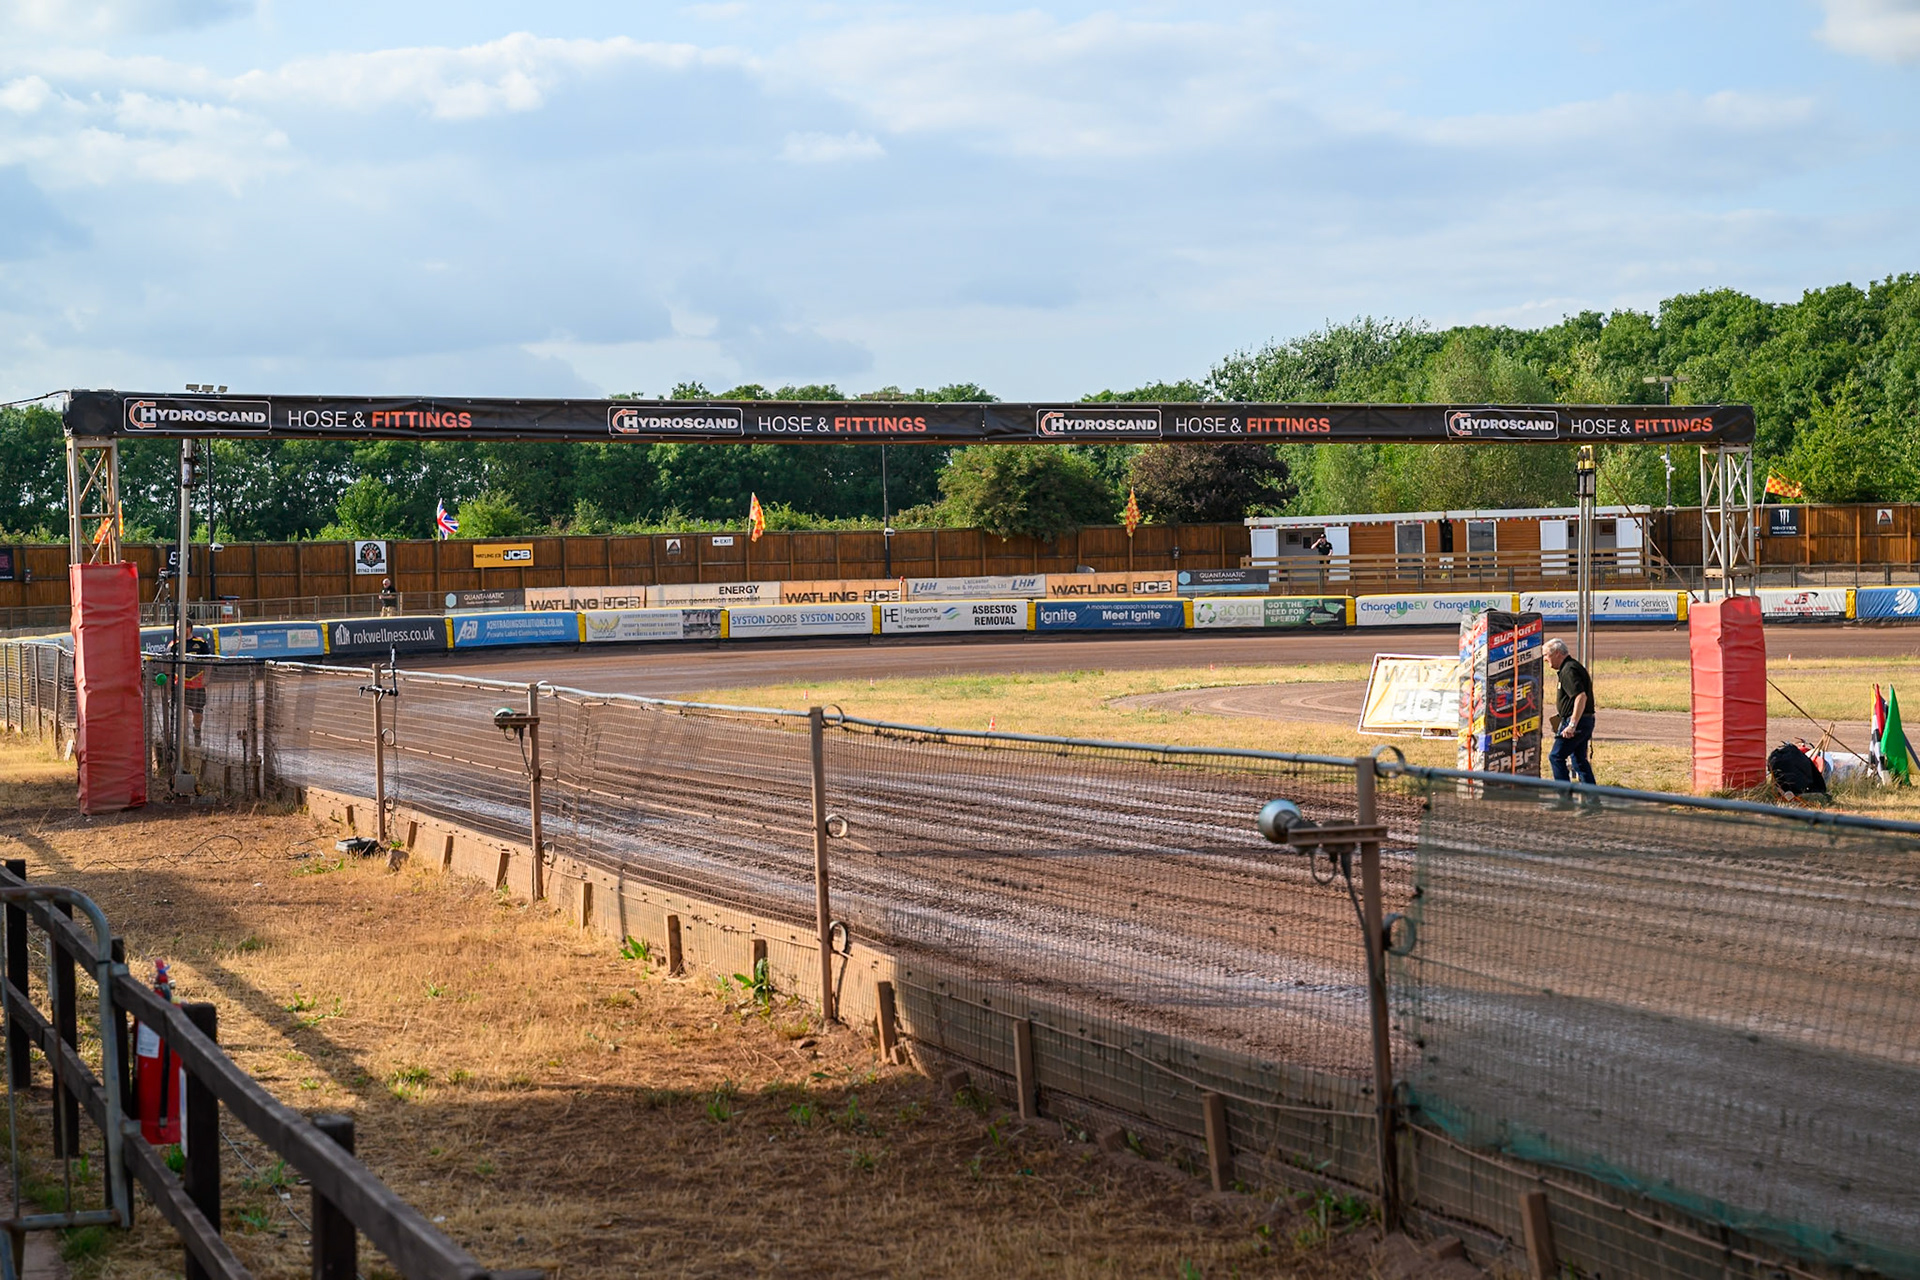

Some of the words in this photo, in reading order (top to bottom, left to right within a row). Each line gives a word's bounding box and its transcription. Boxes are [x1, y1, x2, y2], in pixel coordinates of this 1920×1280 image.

[141, 407, 266, 423] HYDROSCAND
[288, 410, 348, 428] HOSE
[352, 410, 366, 428] &
[371, 410, 472, 428] FITTINGS
[624, 416, 738, 429] HYDROSCAND
[758, 416, 812, 432] HOSE
[817, 416, 830, 433] &
[834, 416, 927, 432] FITTINGS
[1051, 418, 1157, 431] HYDROSCAND
[1176, 417, 1226, 433] HOSE
[1230, 417, 1242, 433] &
[1247, 417, 1330, 433] FITTINGS
[1460, 418, 1554, 431] HYDROSCAND
[1570, 419, 1616, 434] HOSE
[1620, 419, 1631, 434] &
[1635, 417, 1713, 434] FITTINGS
[503, 549, 531, 560] JCB
[719, 585, 760, 595] ENERGY
[913, 582, 937, 593] LHH
[1011, 579, 1036, 591] LHH
[1052, 583, 1127, 596] WATLING
[1133, 580, 1172, 594] JCB
[464, 592, 505, 601] QUANTAMATIC
[689, 597, 727, 606] generation
[728, 595, 760, 603] specialist
[786, 592, 858, 604] WATLING
[864, 590, 900, 602] JCB
[1615, 598, 1640, 608] Metric
[1641, 598, 1668, 608] Services
[530, 598, 598, 611] WATLING
[604, 596, 640, 609] JCB
[904, 606, 938, 614] Heston's
[972, 605, 1017, 615] ASBESTOS
[1220, 603, 1261, 616] acorn
[1361, 600, 1428, 614] ChargeMeEV
[1433, 599, 1500, 612] ChargeMeEV
[1540, 599, 1564, 609] Metric
[731, 614, 765, 625] SYSTON
[766, 613, 797, 624] DOORS
[800, 612, 834, 623] SYSTON
[835, 612, 866, 622] DOORS
[903, 614, 941, 622] Environmental
[974, 616, 1015, 625] REMOVAL
[1040, 608, 1077, 624] ignite
[1102, 610, 1128, 620] Meet
[1131, 610, 1161, 622] Ignite
[353, 626, 435, 644] rokwellness.co.uk
[456, 620, 478, 643] A2B
[1493, 623, 1537, 646] SUPORT
[145, 642, 166, 652] Homes
